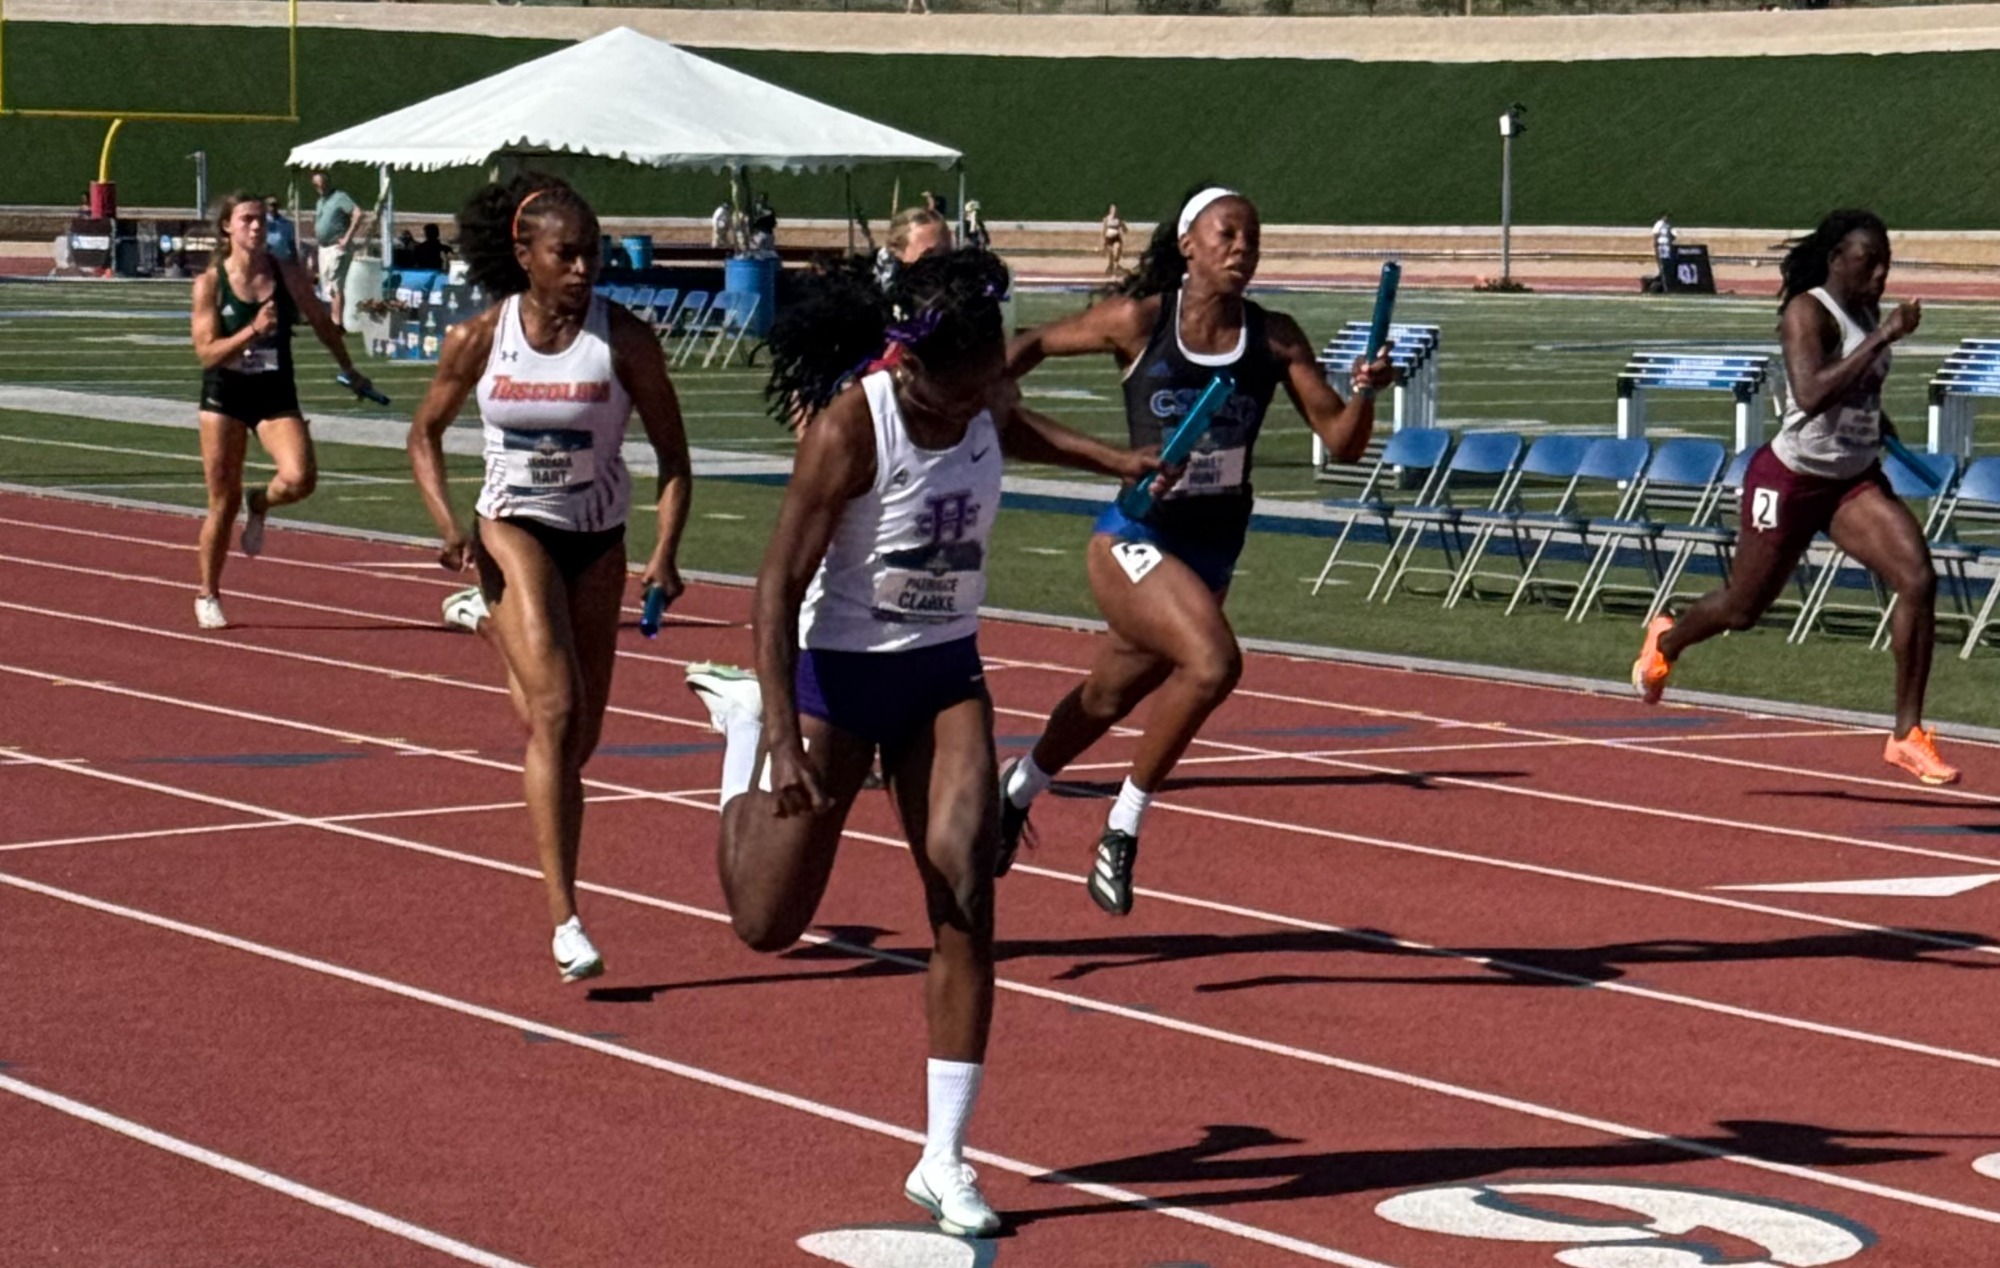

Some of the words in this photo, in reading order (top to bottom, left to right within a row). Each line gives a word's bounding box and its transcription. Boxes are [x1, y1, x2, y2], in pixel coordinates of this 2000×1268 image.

[531, 469, 569, 485] HART
[1758, 492, 1772, 525] 2
[897, 591, 958, 612] CLARKE
